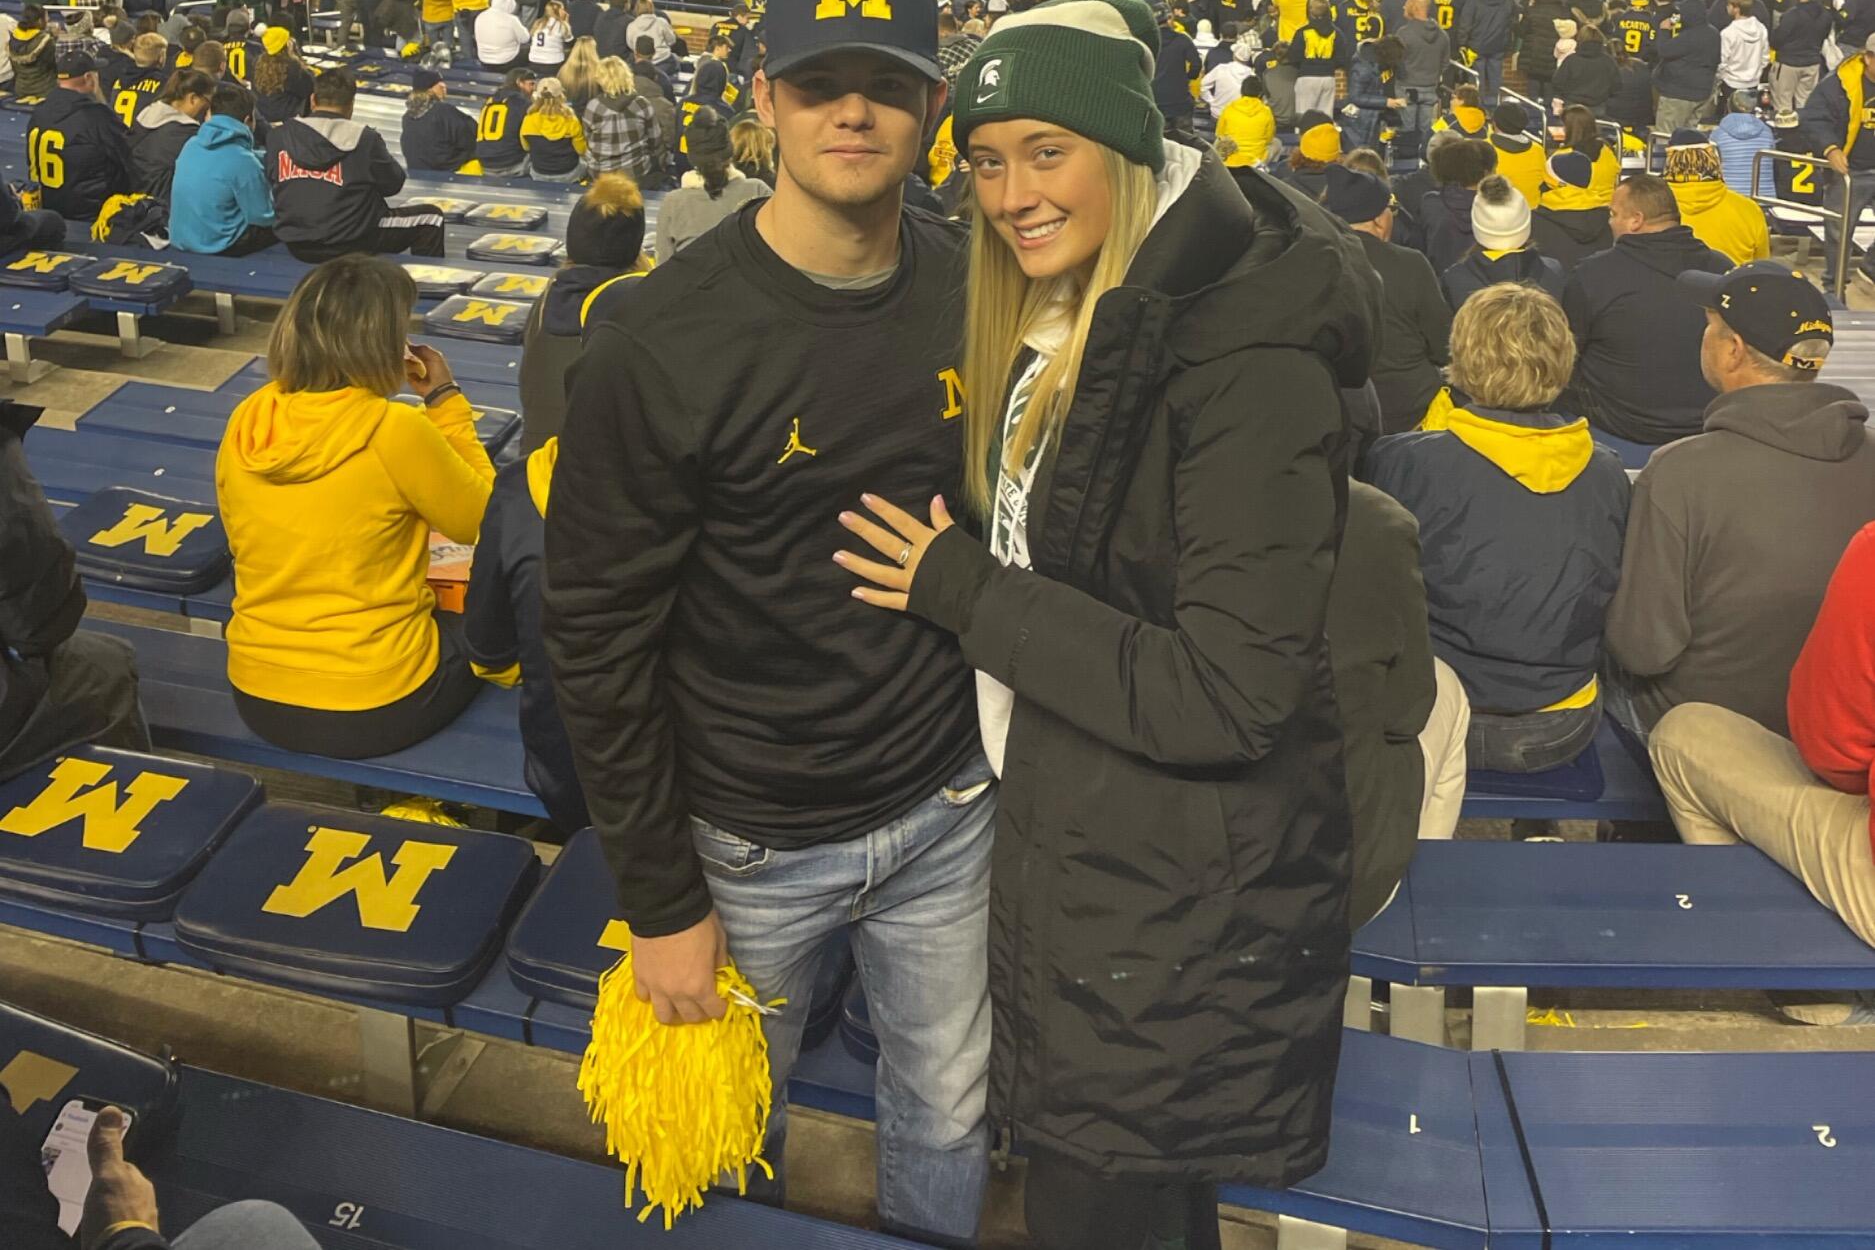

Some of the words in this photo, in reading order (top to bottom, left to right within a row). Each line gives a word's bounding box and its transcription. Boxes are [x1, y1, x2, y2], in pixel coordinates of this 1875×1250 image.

[1624, 30, 1642, 53] 9
[113, 89, 138, 127] 9
[28, 126, 65, 189] 16
[1790, 153, 1816, 194] 2
[1812, 1125, 1838, 1148] 2
[329, 1202, 364, 1228] 15
